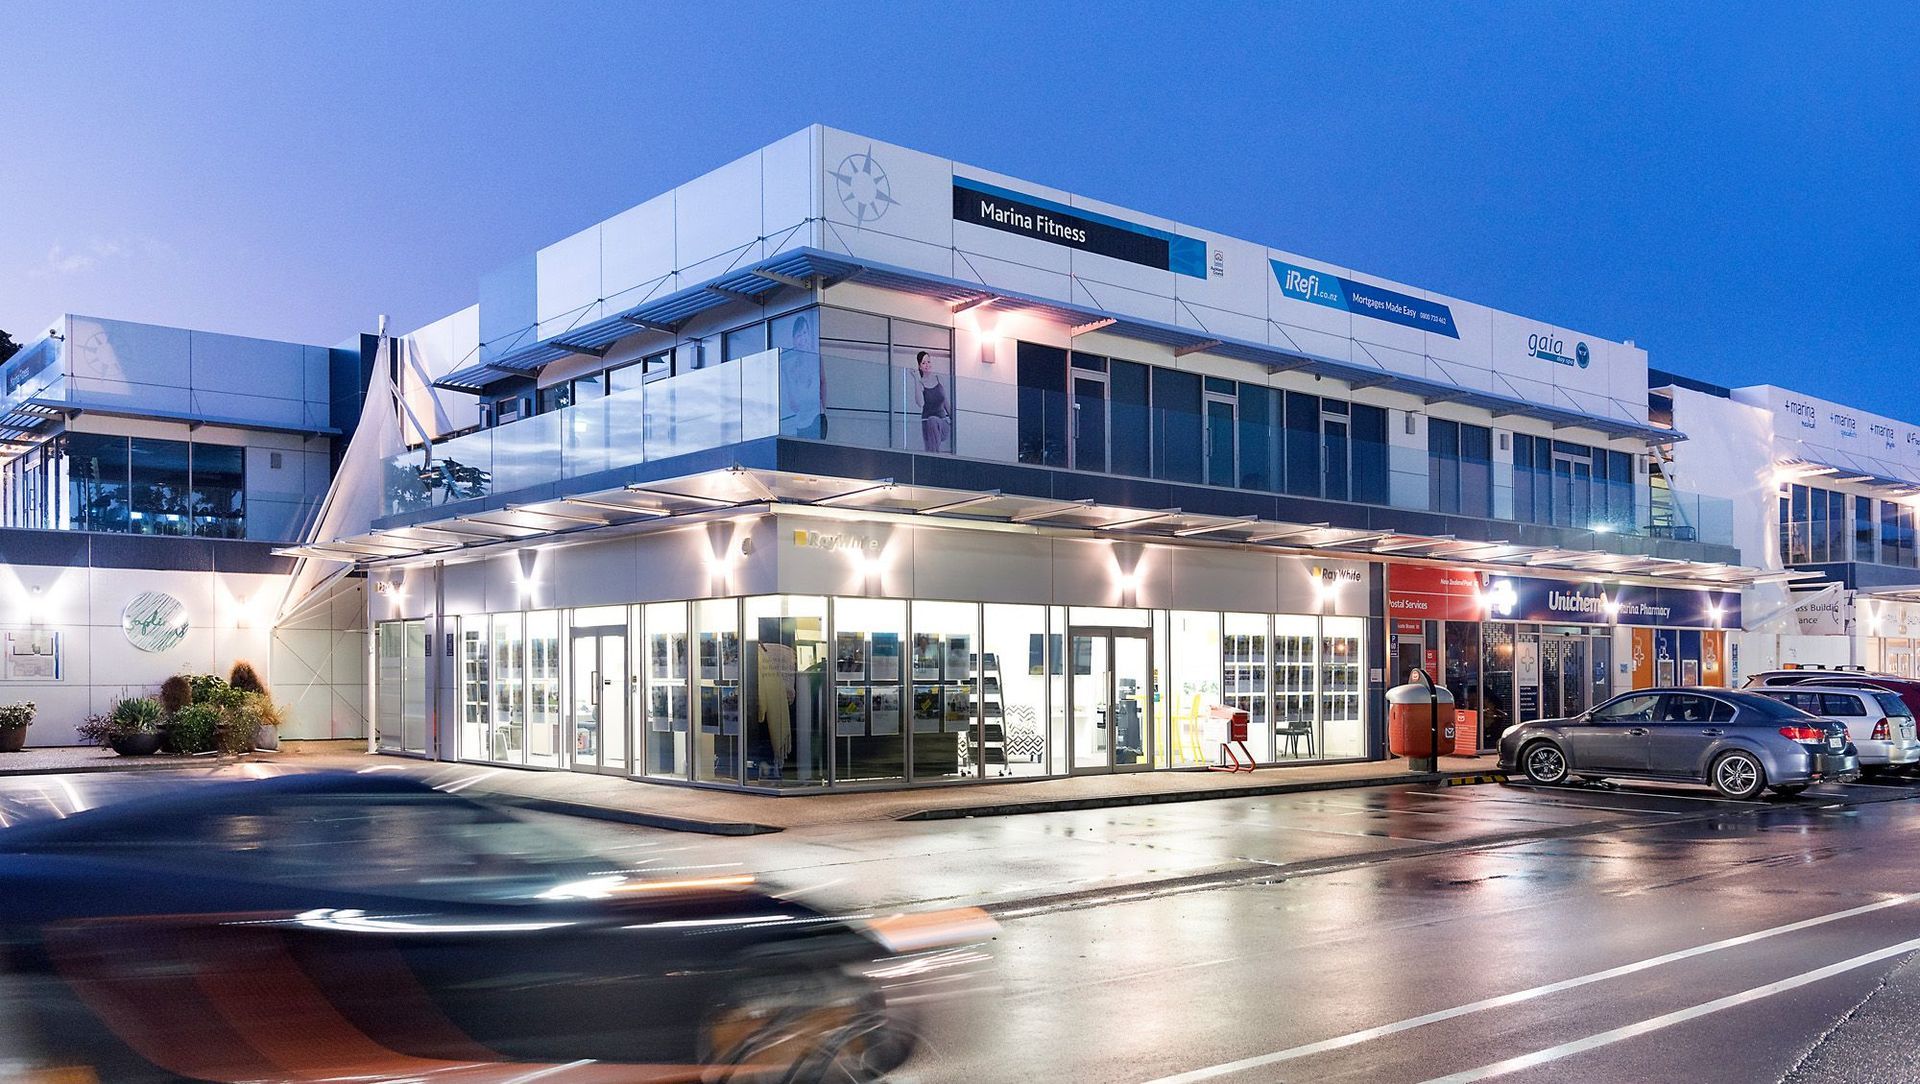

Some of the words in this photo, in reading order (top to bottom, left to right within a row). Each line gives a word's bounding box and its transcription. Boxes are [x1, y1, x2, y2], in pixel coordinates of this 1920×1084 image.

[980, 200, 1032, 230] Marina
[1036, 215, 1086, 242] Fitness
[1352, 292, 1385, 310] Mortgages
[1385, 301, 1402, 314] Made
[1402, 305, 1417, 319] Easy
[1528, 333, 1564, 357] gaia
[1791, 401, 1815, 419] marina
[1834, 413, 1856, 430] marina
[1874, 423, 1894, 439] marina
[809, 529, 837, 552] Ray
[1322, 569, 1337, 582] Ray
[1338, 569, 1361, 582] White
[1405, 600, 1428, 610] Services
[1548, 589, 1601, 613] Unichem
[1639, 603, 1671, 619] Pharmacy
